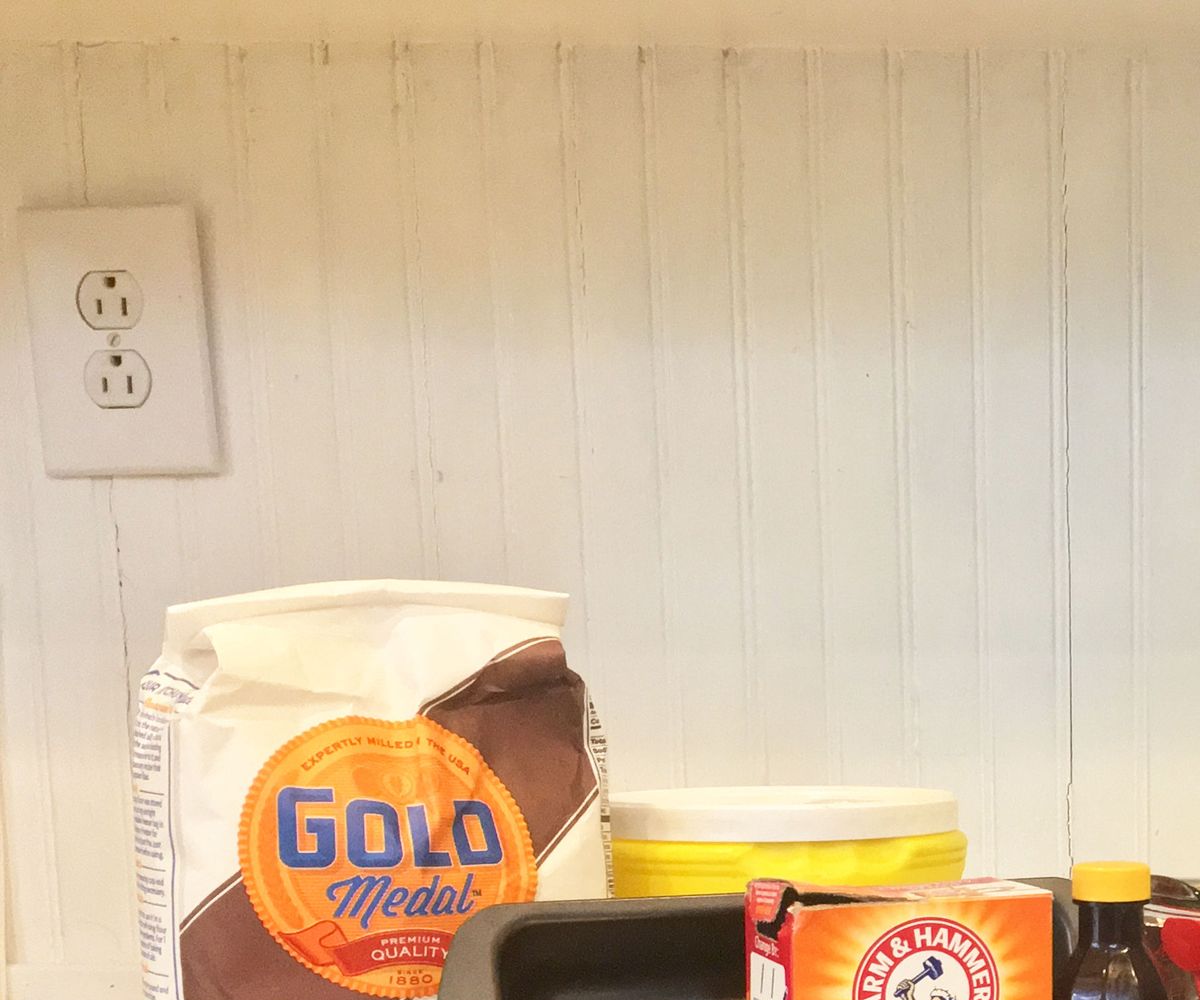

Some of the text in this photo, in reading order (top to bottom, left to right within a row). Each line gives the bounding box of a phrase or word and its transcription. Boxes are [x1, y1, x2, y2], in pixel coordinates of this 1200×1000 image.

[300, 736, 362, 771] EXPERTLY
[367, 737, 413, 749] MILLED
[426, 738, 446, 755] THE
[448, 754, 471, 775] USA
[276, 785, 503, 869] GOLD
[326, 872, 474, 929] Medal
[381, 936, 441, 947] PREMIUM
[889, 936, 912, 958] &
[370, 946, 449, 961] QUALITY
[389, 974, 433, 985] 1880
